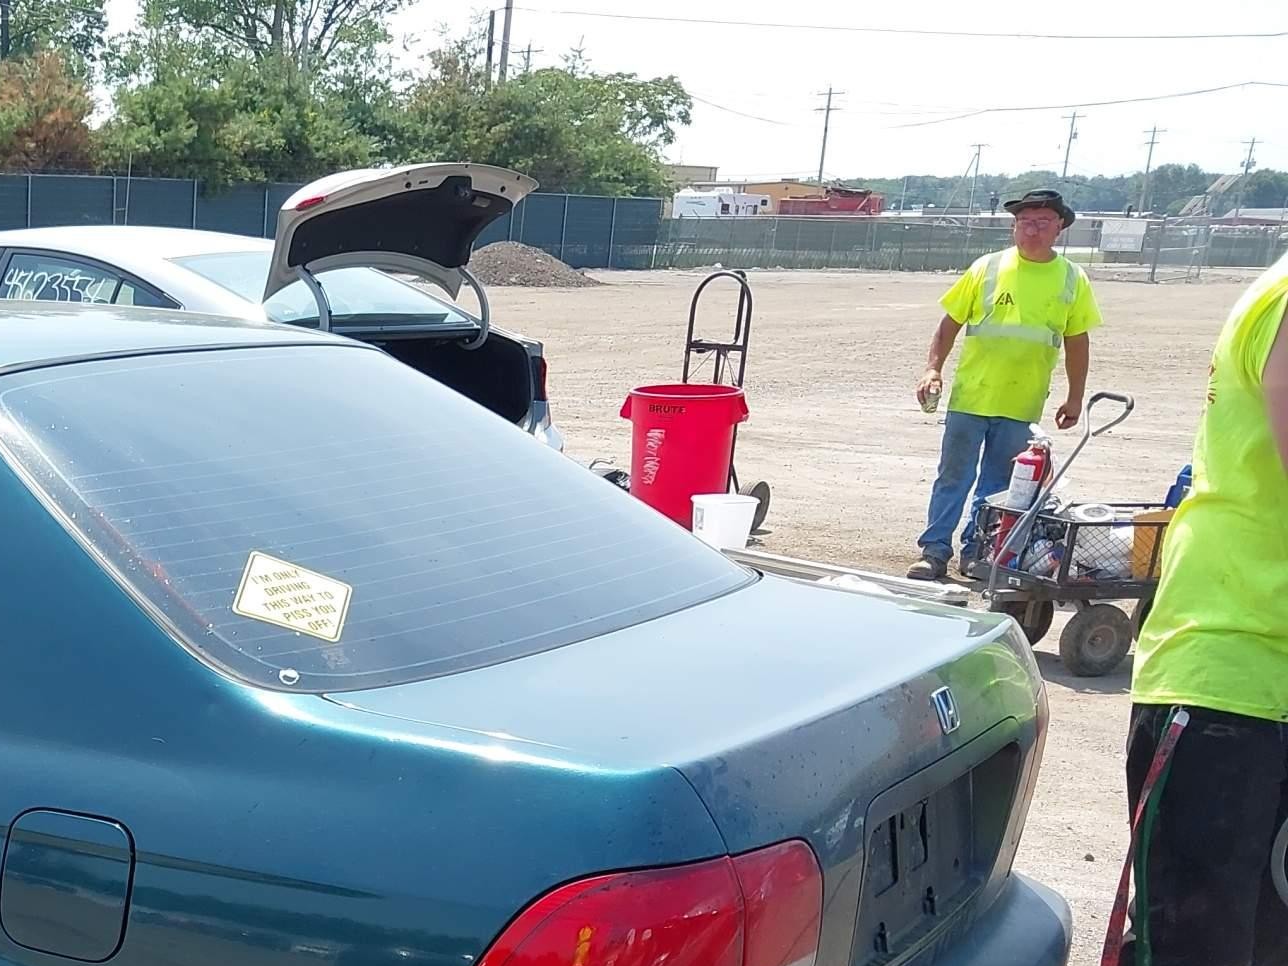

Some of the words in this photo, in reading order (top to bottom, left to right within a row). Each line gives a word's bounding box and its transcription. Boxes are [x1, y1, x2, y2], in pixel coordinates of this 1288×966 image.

[648, 404, 685, 415] BRUTE
[252, 573, 273, 585] I'M
[273, 569, 300, 581] ONLY
[264, 581, 311, 597] DRIVING
[263, 598, 290, 612] THIS
[290, 594, 315, 606] WAY
[317, 591, 334, 601] TO
[283, 608, 313, 622] PISS
[312, 604, 337, 616] YOU
[308, 618, 336, 631] OFF!
